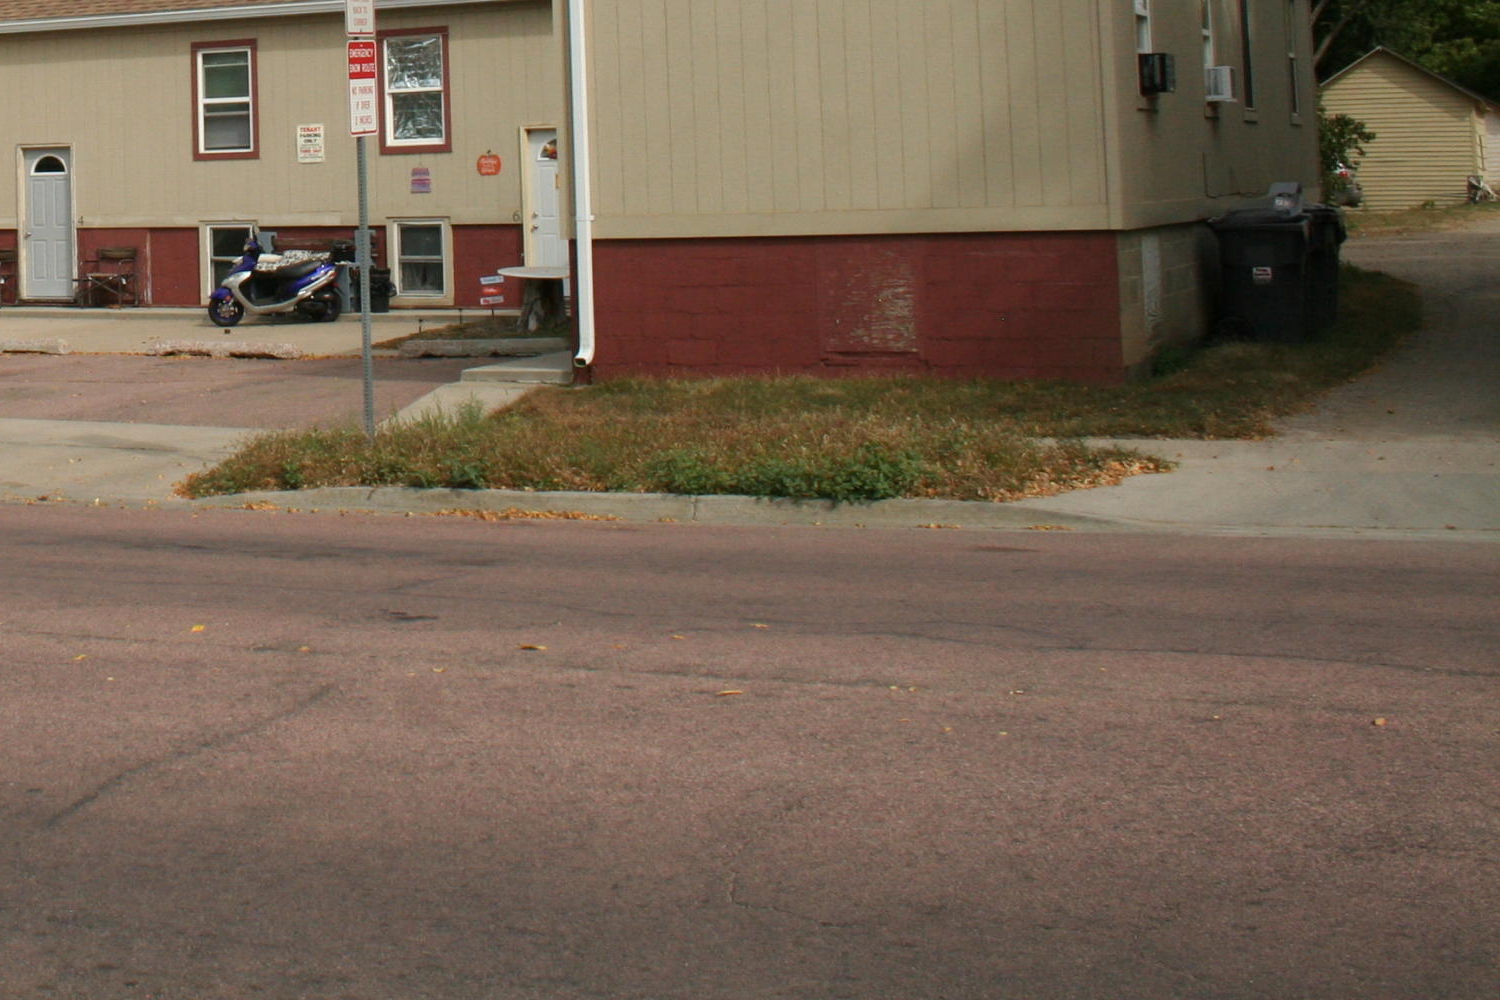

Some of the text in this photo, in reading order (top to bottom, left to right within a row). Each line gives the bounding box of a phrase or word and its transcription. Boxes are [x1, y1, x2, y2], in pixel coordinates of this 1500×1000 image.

[349, 49, 373, 58] EMERGENCY
[349, 63, 375, 73] SNOW ROUTE
[358, 86, 373, 95] PARKING
[77, 215, 84, 224] 4
